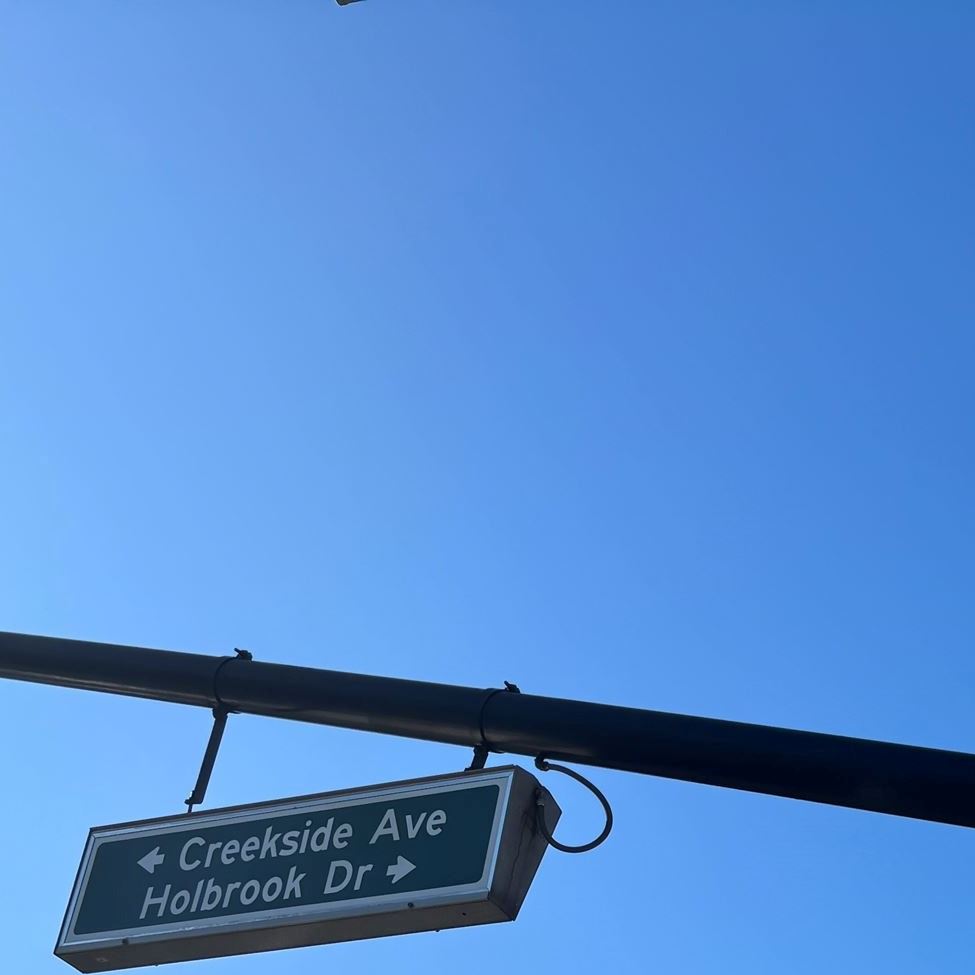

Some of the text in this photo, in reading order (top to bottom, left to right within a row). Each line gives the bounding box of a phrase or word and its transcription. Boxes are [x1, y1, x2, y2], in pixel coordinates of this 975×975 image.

[179, 808, 448, 872] Creekside Ave
[139, 860, 374, 919] Holbrook Dr
